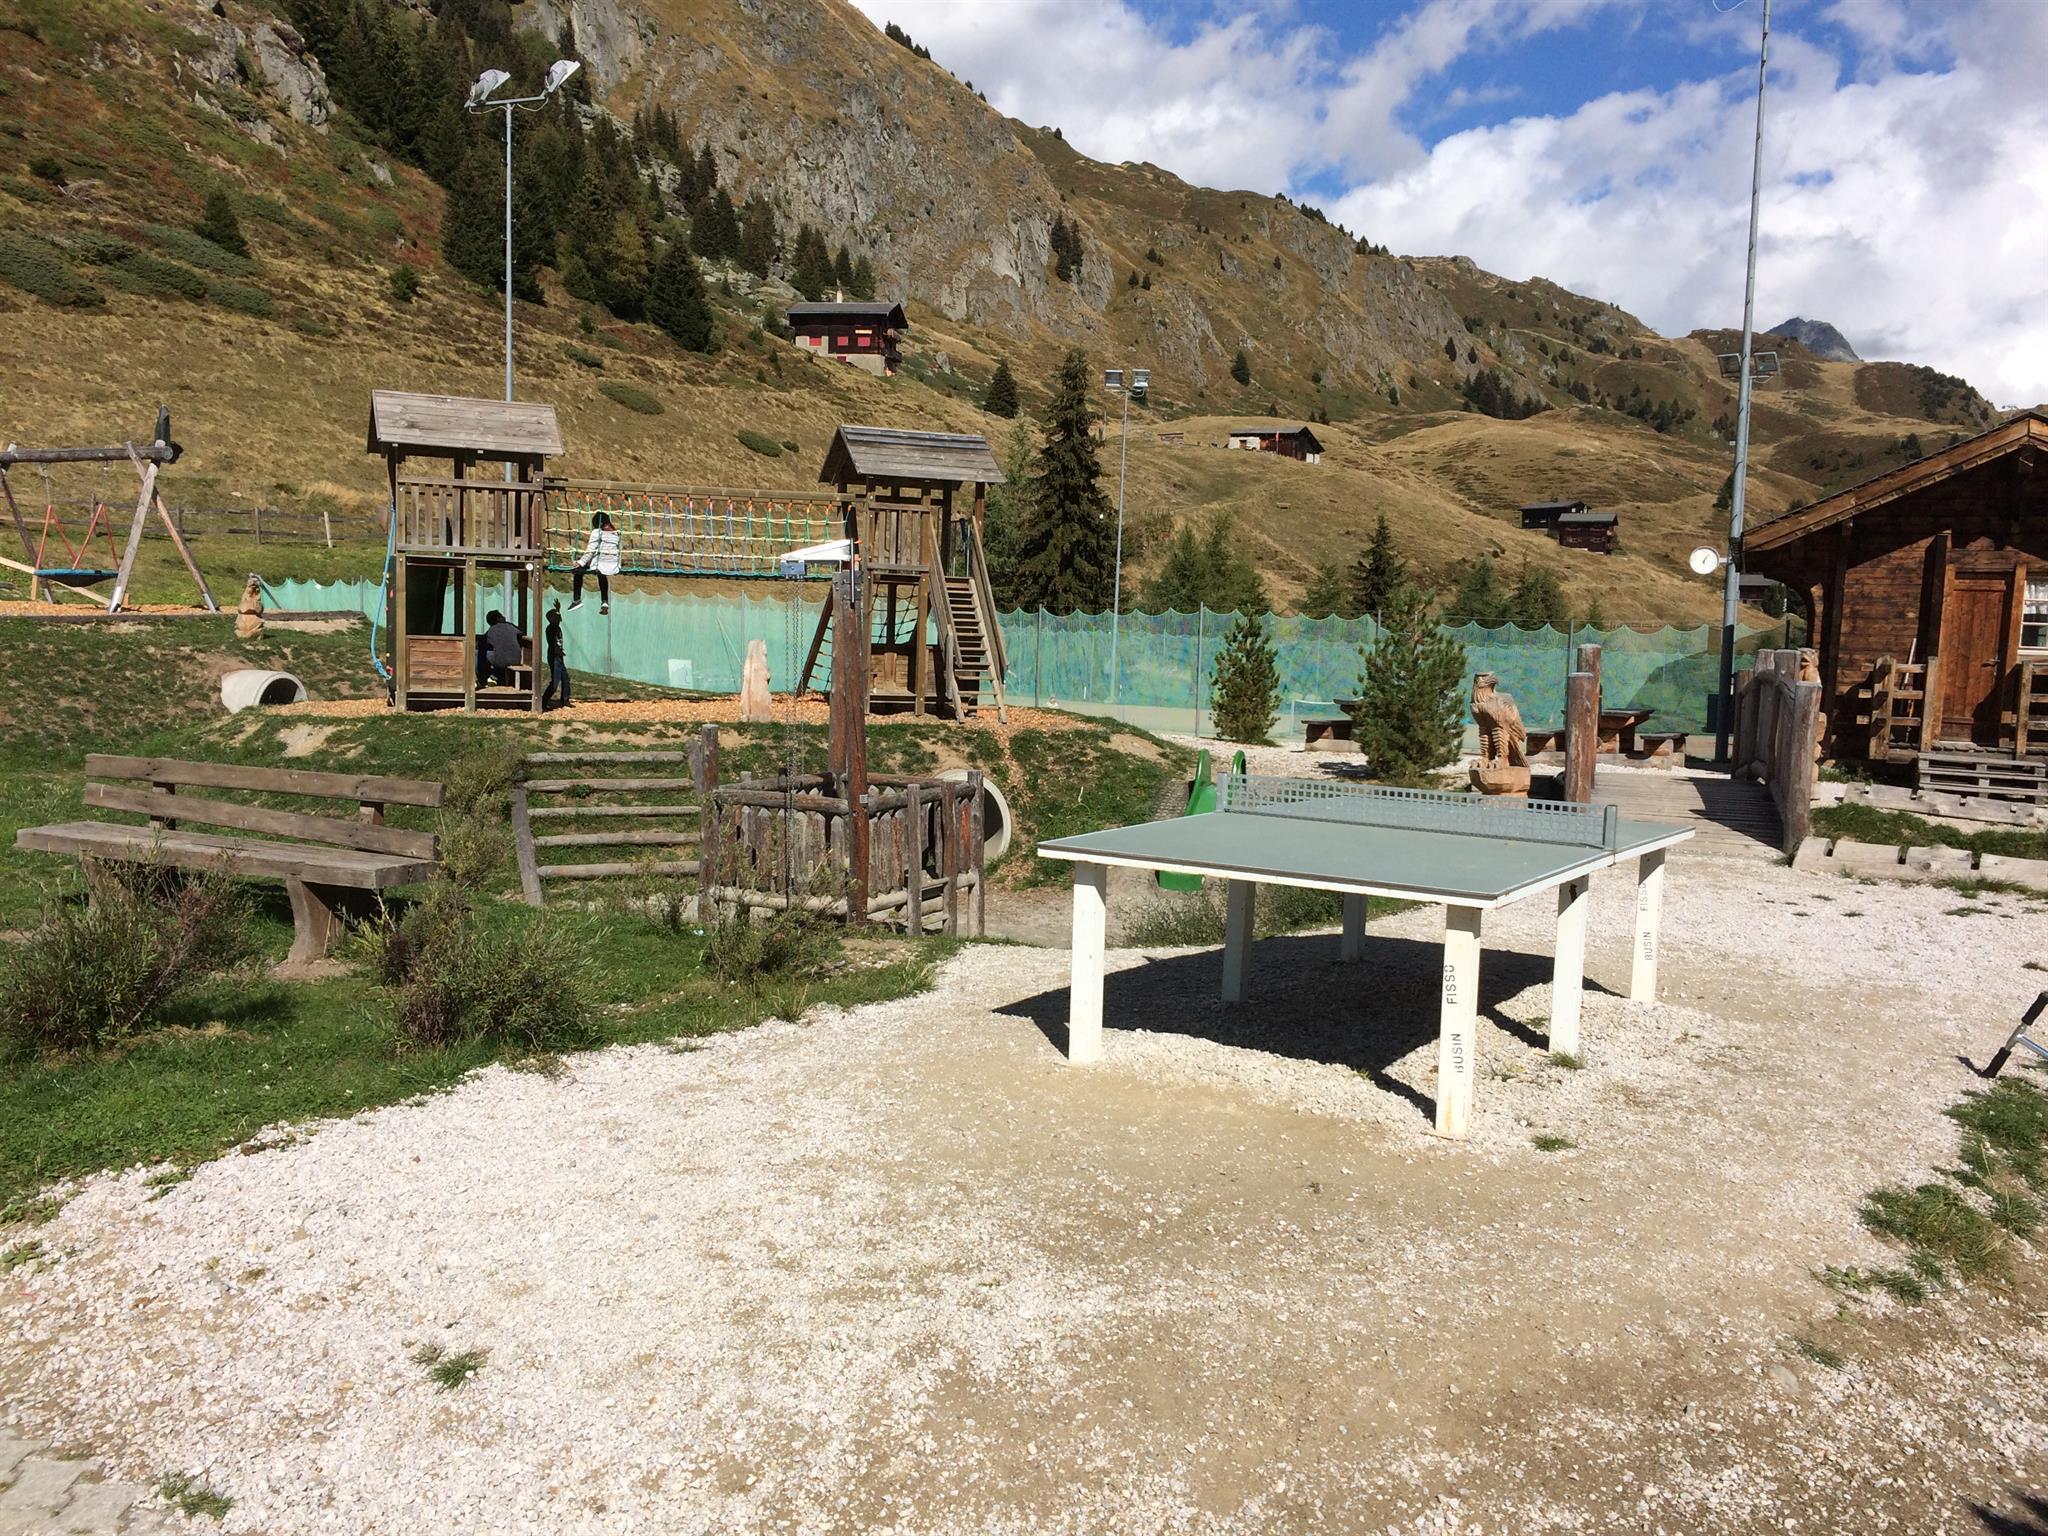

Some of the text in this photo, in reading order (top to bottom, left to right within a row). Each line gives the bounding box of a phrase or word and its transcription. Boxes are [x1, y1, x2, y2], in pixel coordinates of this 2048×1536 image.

[1642, 931, 1653, 961] BUSIN
[1444, 964, 1464, 1073] BUSIN FISSO
